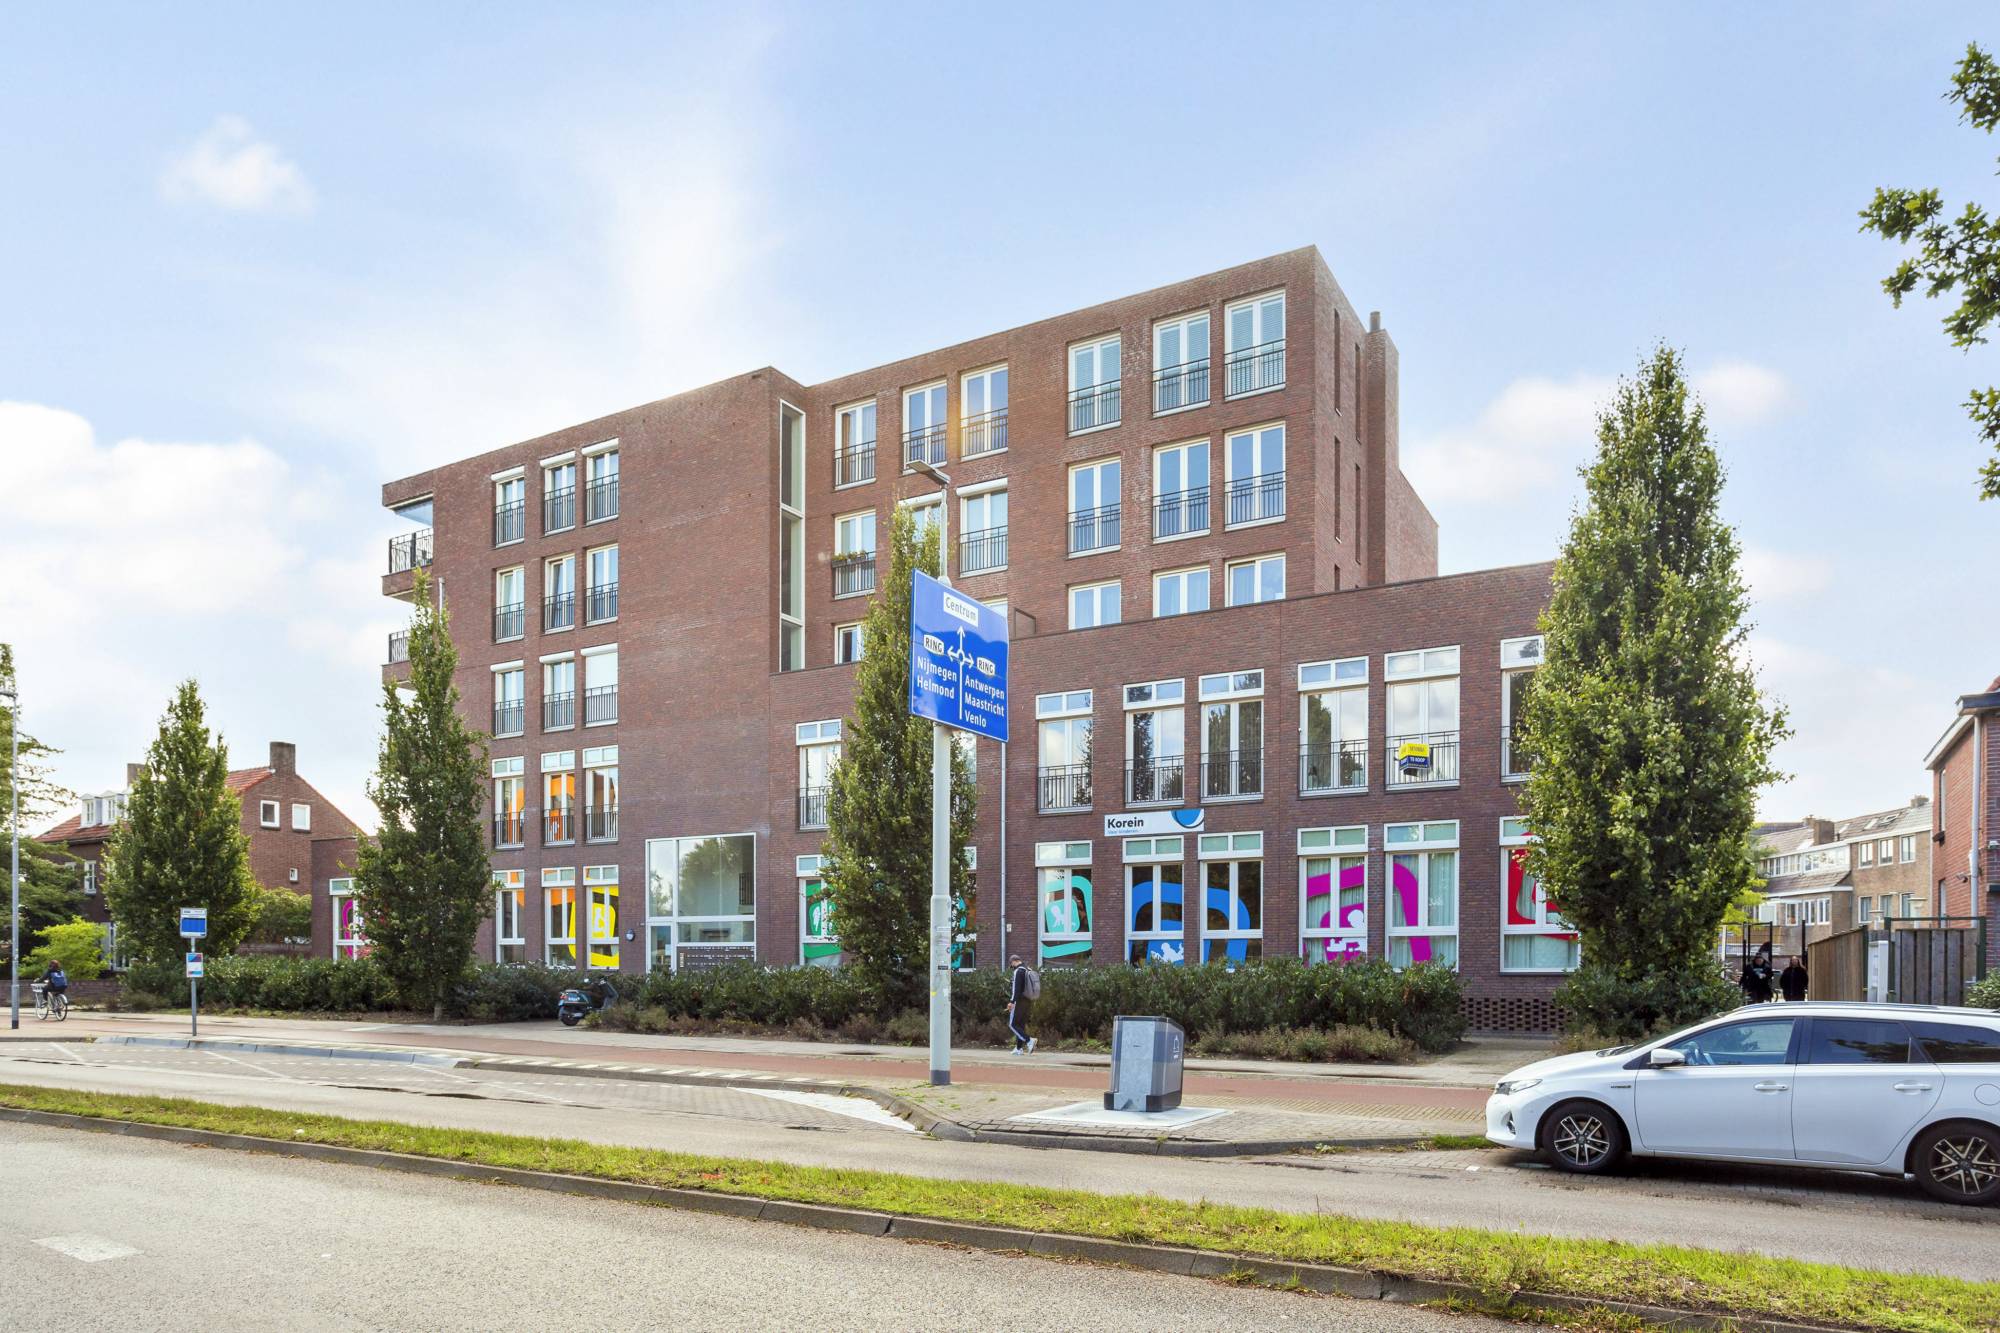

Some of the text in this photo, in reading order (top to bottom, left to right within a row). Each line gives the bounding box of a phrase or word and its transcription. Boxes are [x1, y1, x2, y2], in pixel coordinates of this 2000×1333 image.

[945, 597, 977, 621] Centrum
[925, 638, 943, 653] RING
[917, 655, 957, 682] Nijmegen
[978, 660, 994, 674] RING
[917, 676, 955, 699] Helmond
[964, 675, 1005, 700] Antwerpen
[964, 692, 1005, 717] Maastricht
[964, 709, 987, 728] Venlo
[1107, 817, 1144, 829] Korein
